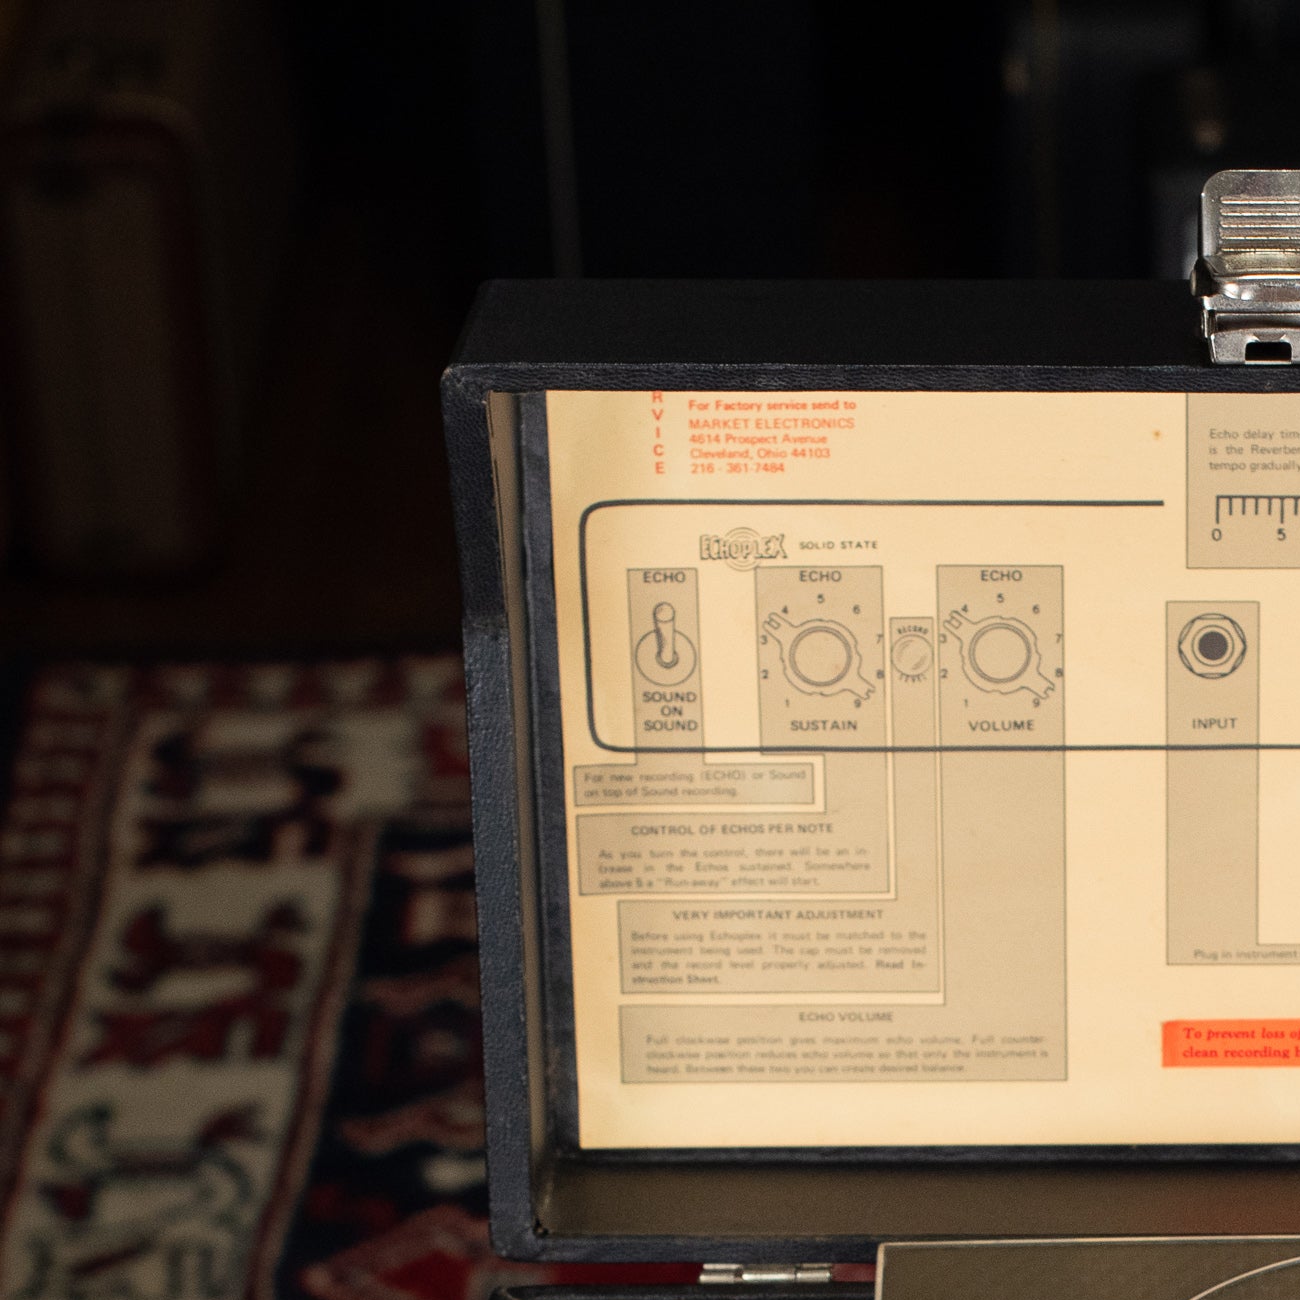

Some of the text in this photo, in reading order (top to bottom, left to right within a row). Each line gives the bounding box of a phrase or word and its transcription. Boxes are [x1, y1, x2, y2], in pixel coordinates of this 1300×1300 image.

[688, 400, 856, 412] For Factory service send to
[689, 418, 855, 429] MARKET ELECTRONICS
[689, 434, 828, 445] 4614 Prospect Avenue
[1209, 429, 1239, 440] Echo
[1243, 429, 1274, 441] delay
[690, 448, 831, 460] Cleveland, Ohio 44103
[1209, 445, 1217, 455] is
[1226, 445, 1244, 455] the
[691, 463, 714, 474] 216
[1209, 461, 1246, 472] tempo
[1211, 527, 1222, 541] 0
[1277, 528, 1286, 541] 5
[700, 534, 788, 560] ECHOPLEX
[800, 541, 878, 549] SOLID STATE
[643, 571, 686, 583] ECHO
[799, 570, 842, 582] ECHO
[980, 570, 1023, 582] ECHO
[643, 691, 696, 702] SOUND
[660, 705, 683, 716] ON
[644, 720, 698, 731] SOUND
[790, 720, 858, 731] SUSTAIN
[968, 719, 1035, 731] VOLUME
[1192, 718, 1238, 730] INPUT
[631, 823, 833, 836] CONTROL OF ECHOS PER NOTE
[673, 909, 883, 920] VERY IMPORTANT ADJUSTMENT
[799, 1012, 893, 1022] ECHO VOLUME
[1183, 1028, 1202, 1039] To
[1207, 1028, 1256, 1041] prevent
[1261, 1028, 1284, 1039] loss
[1183, 1047, 1219, 1058] clean
[1224, 1046, 1290, 1059] recording
